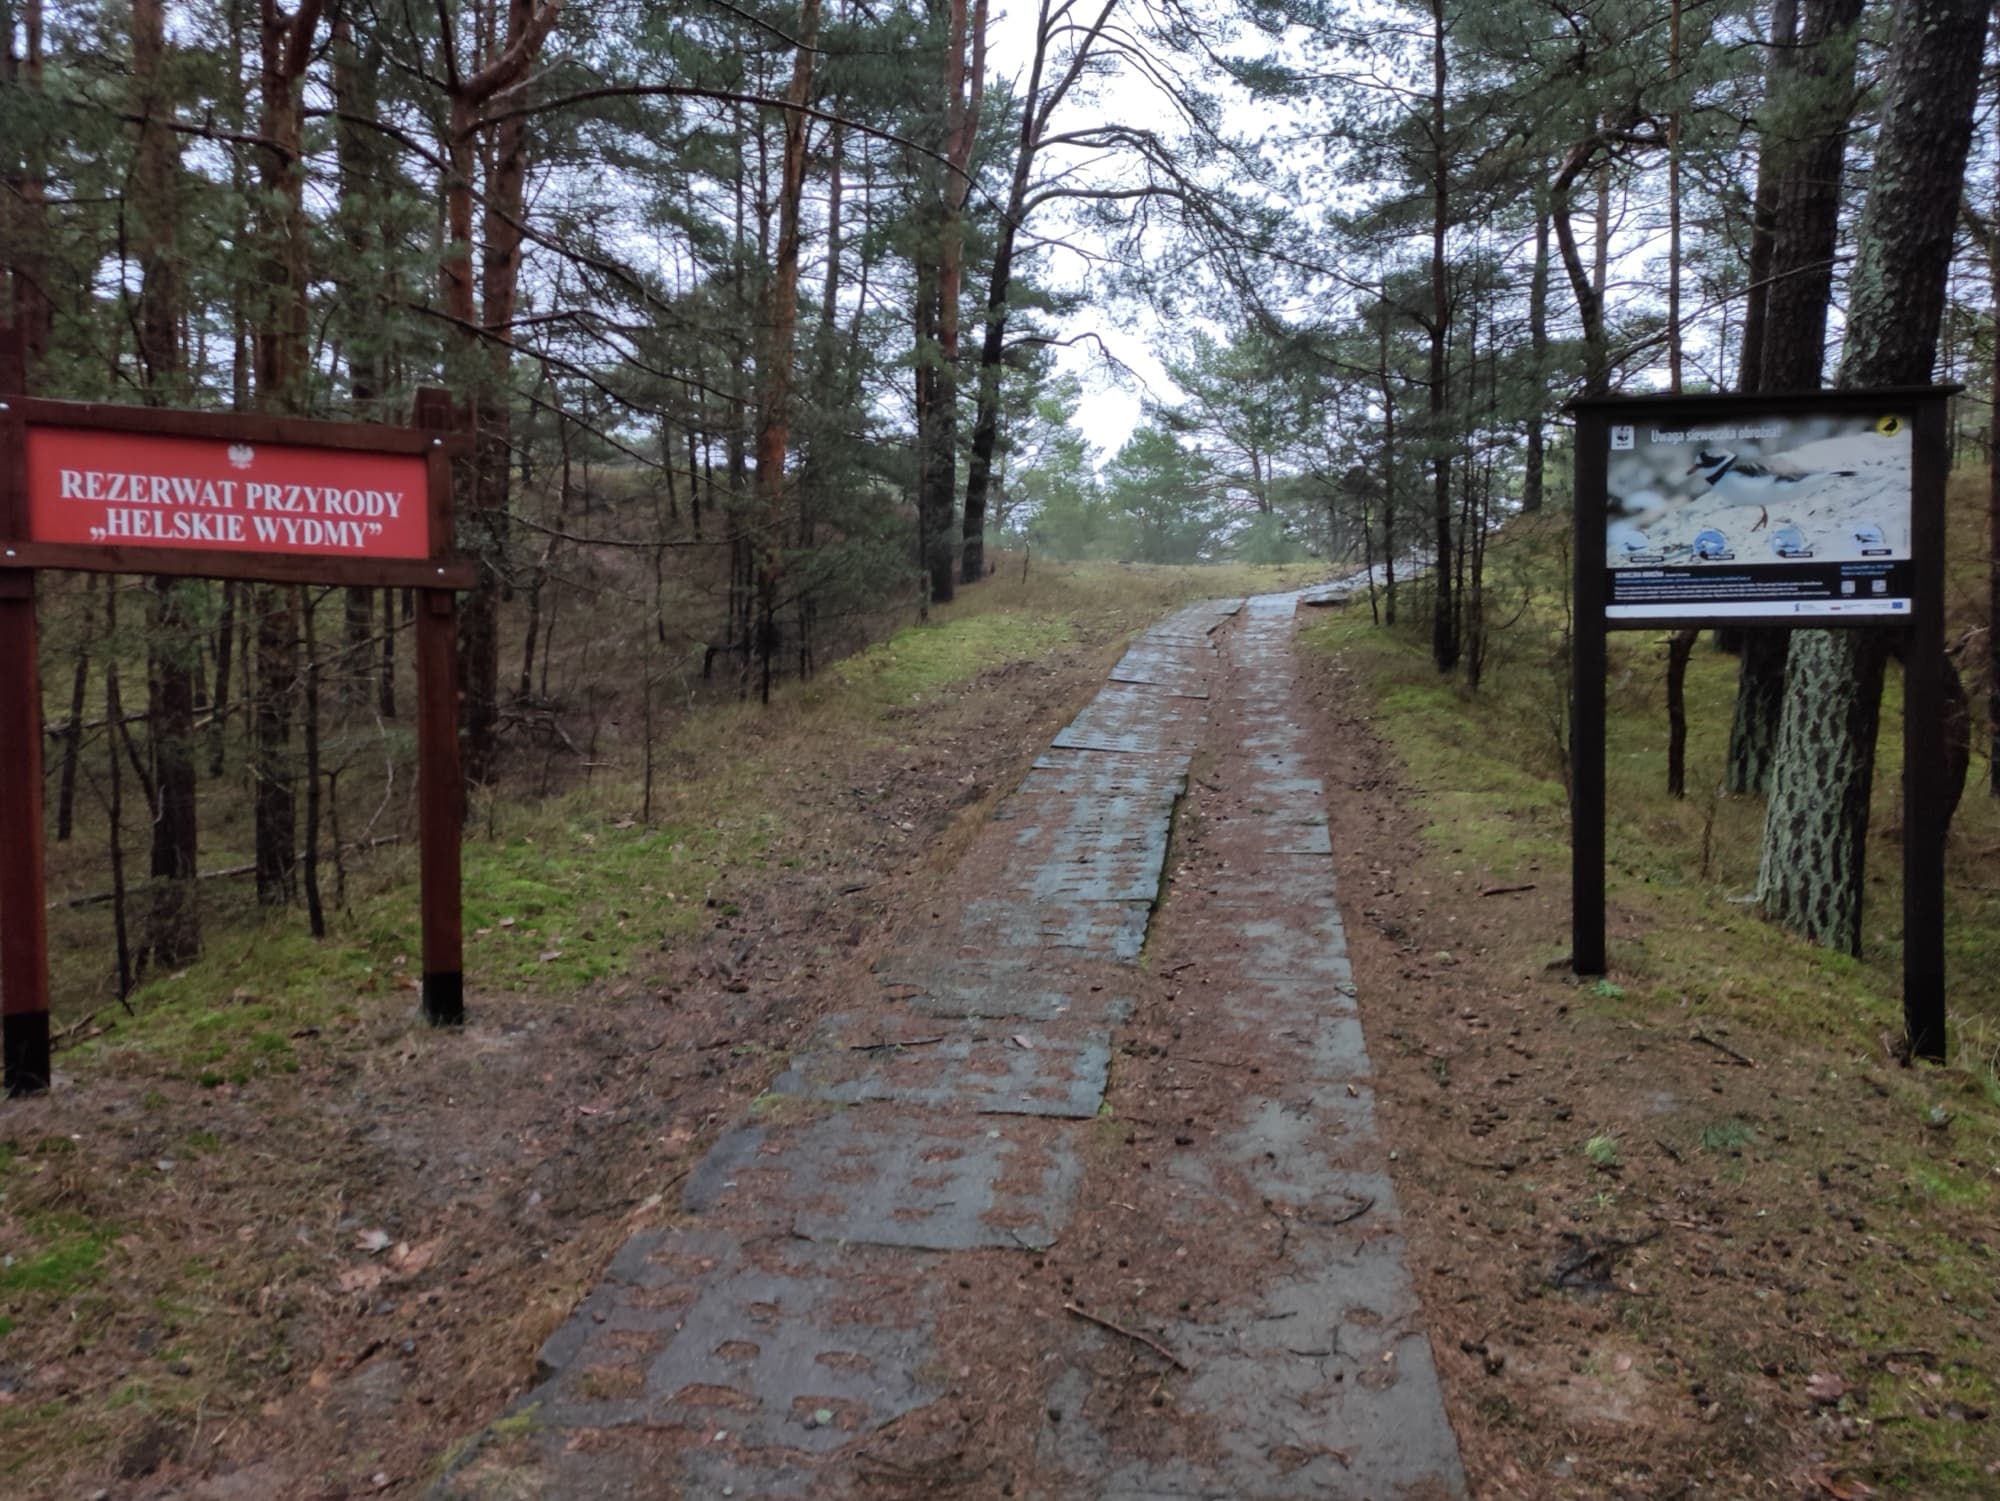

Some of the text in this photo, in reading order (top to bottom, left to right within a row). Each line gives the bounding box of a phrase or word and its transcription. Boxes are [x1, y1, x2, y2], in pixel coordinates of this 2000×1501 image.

[1651, 428, 1685, 445] Uwaga
[60, 469, 403, 518] REZERWAT PRZYRODY
[89, 508, 382, 548] „HELSKIE WYDMY”
